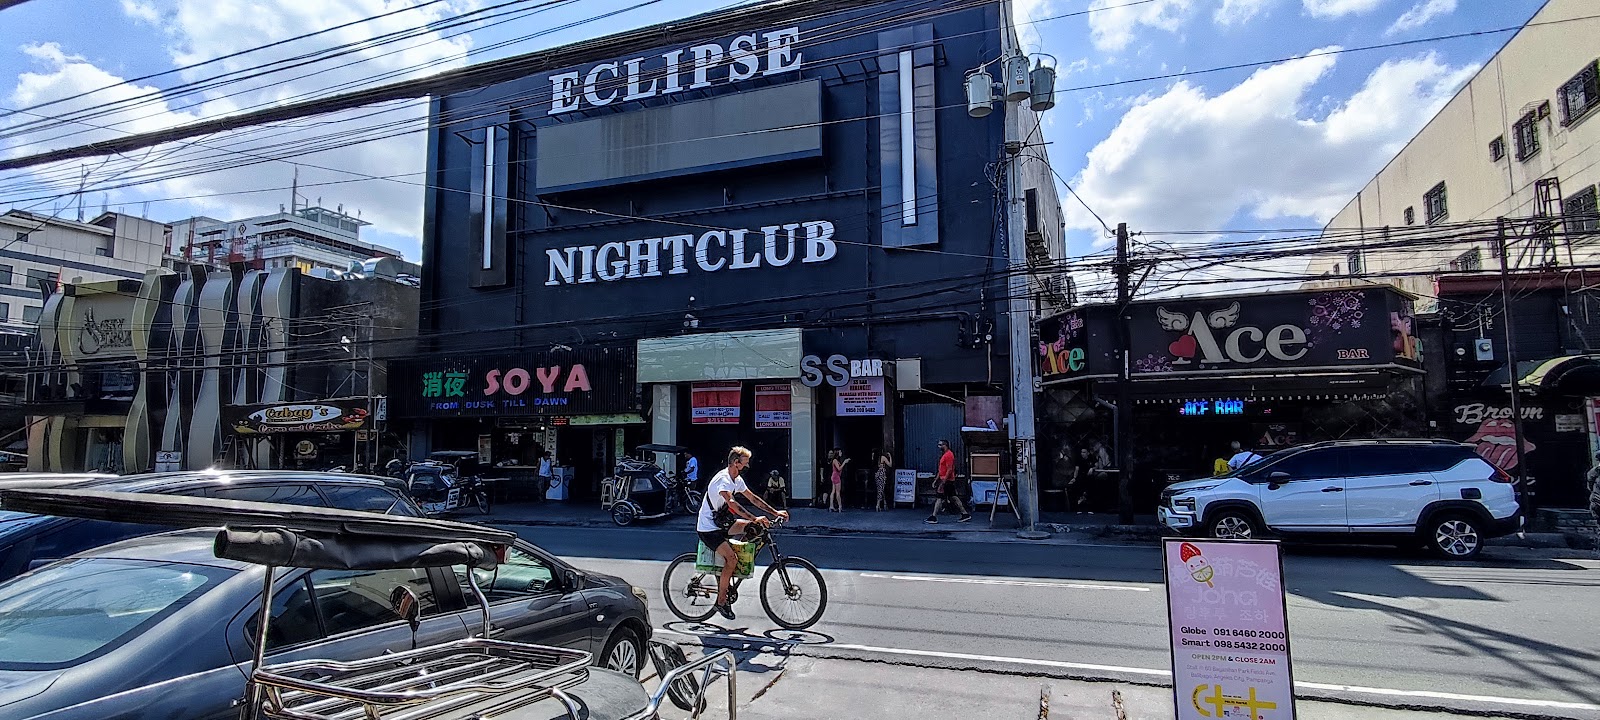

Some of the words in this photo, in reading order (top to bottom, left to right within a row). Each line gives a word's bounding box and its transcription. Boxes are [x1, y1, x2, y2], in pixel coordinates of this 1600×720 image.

[548, 26, 803, 116] ECLIPSE
[544, 220, 838, 287] NIGHTCLUB
[1171, 310, 1309, 364] Ace
[1042, 342, 1086, 377] Ace
[1337, 348, 1370, 360] BAR
[422, 371, 468, 398] 消夜
[483, 363, 593, 396] SOYA
[801, 354, 850, 387] SS
[850, 359, 884, 378] BAR
[430, 402, 459, 410] FROM
[465, 400, 495, 409] DUSK
[502, 399, 526, 407] TILL
[534, 397, 568, 406] DAWN
[1180, 626, 1207, 635] Globe
[1213, 628, 1231, 636] 091
[1232, 629, 1257, 638] 6460
[1258, 630, 1285, 639] 2000
[1181, 638, 1211, 647] Smart
[1213, 640, 1232, 648] 098
[1233, 641, 1258, 650] 5432
[1259, 642, 1286, 651] 2000
[1191, 653, 1211, 661] OPEN
[1211, 654, 1227, 662] 2PM
[1234, 656, 1258, 664] CLOSE
